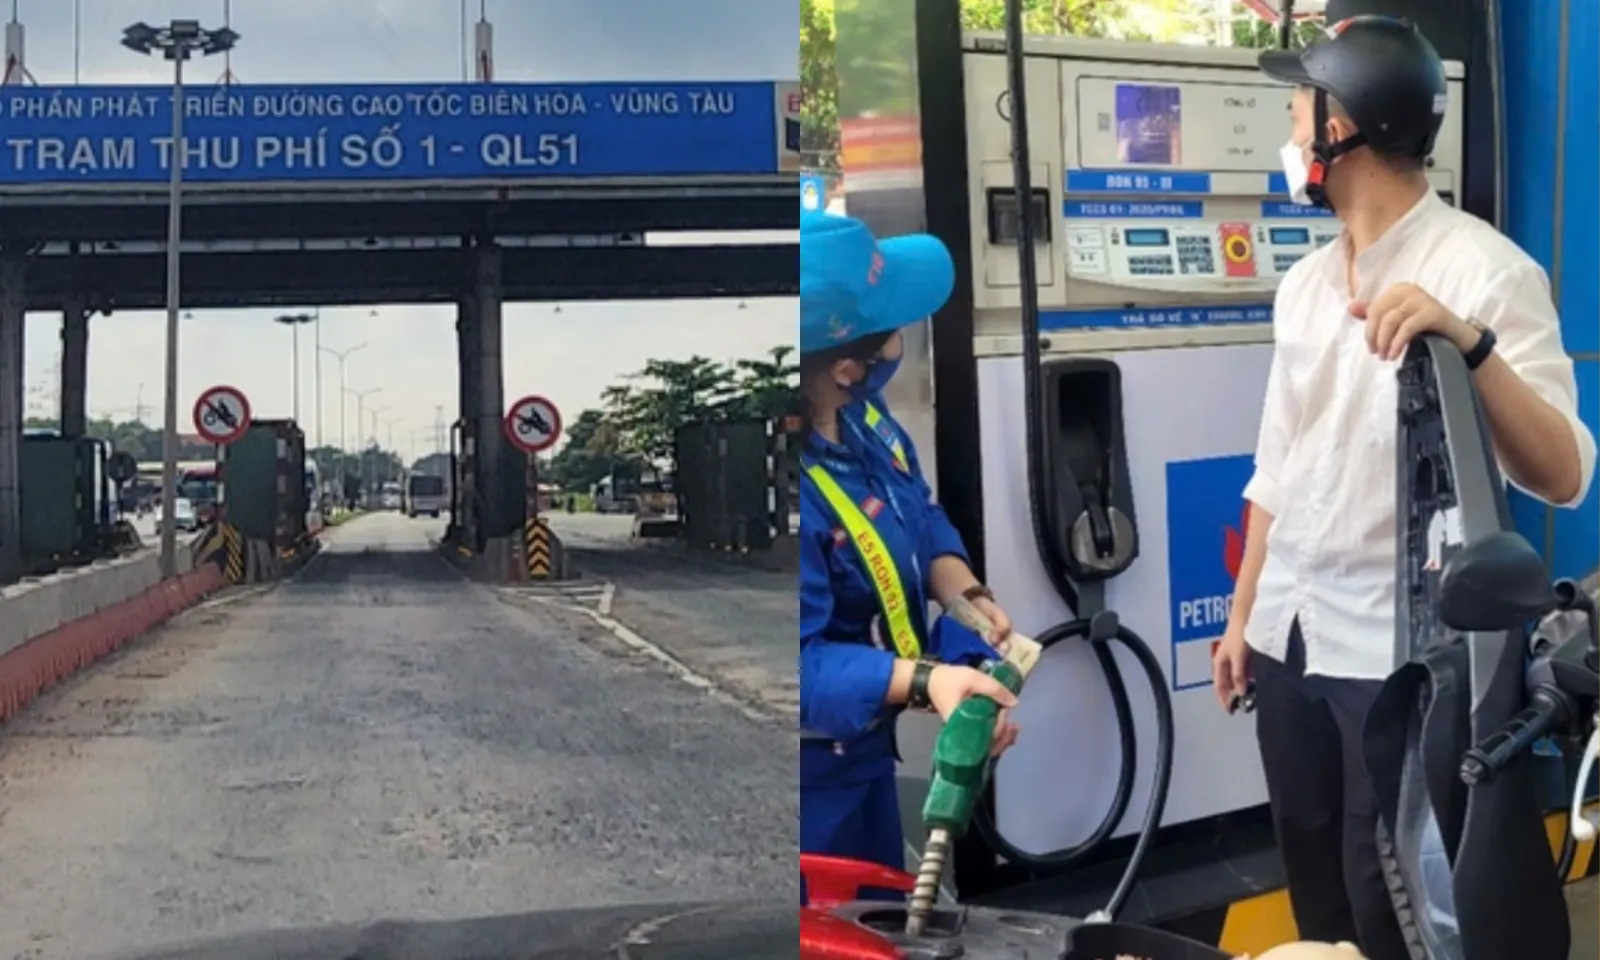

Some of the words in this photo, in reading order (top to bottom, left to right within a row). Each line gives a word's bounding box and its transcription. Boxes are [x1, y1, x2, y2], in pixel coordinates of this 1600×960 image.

[91, 91, 158, 118] PHÁT
[253, 89, 343, 117] ĐƯỜNG
[352, 94, 403, 116] CAO
[411, 87, 463, 116] TỐC
[470, 89, 528, 116] BIÊN
[533, 89, 587, 115] HÒA
[610, 88, 678, 114] VŨNG
[689, 87, 734, 113] TÀU
[6, 137, 135, 175] TRẠM
[151, 136, 239, 169] THU
[257, 126, 328, 168] PHÍ
[341, 122, 402, 167] SỐ
[420, 135, 435, 166] 1
[450, 144, 464, 152] -
[481, 133, 578, 168] QL51
